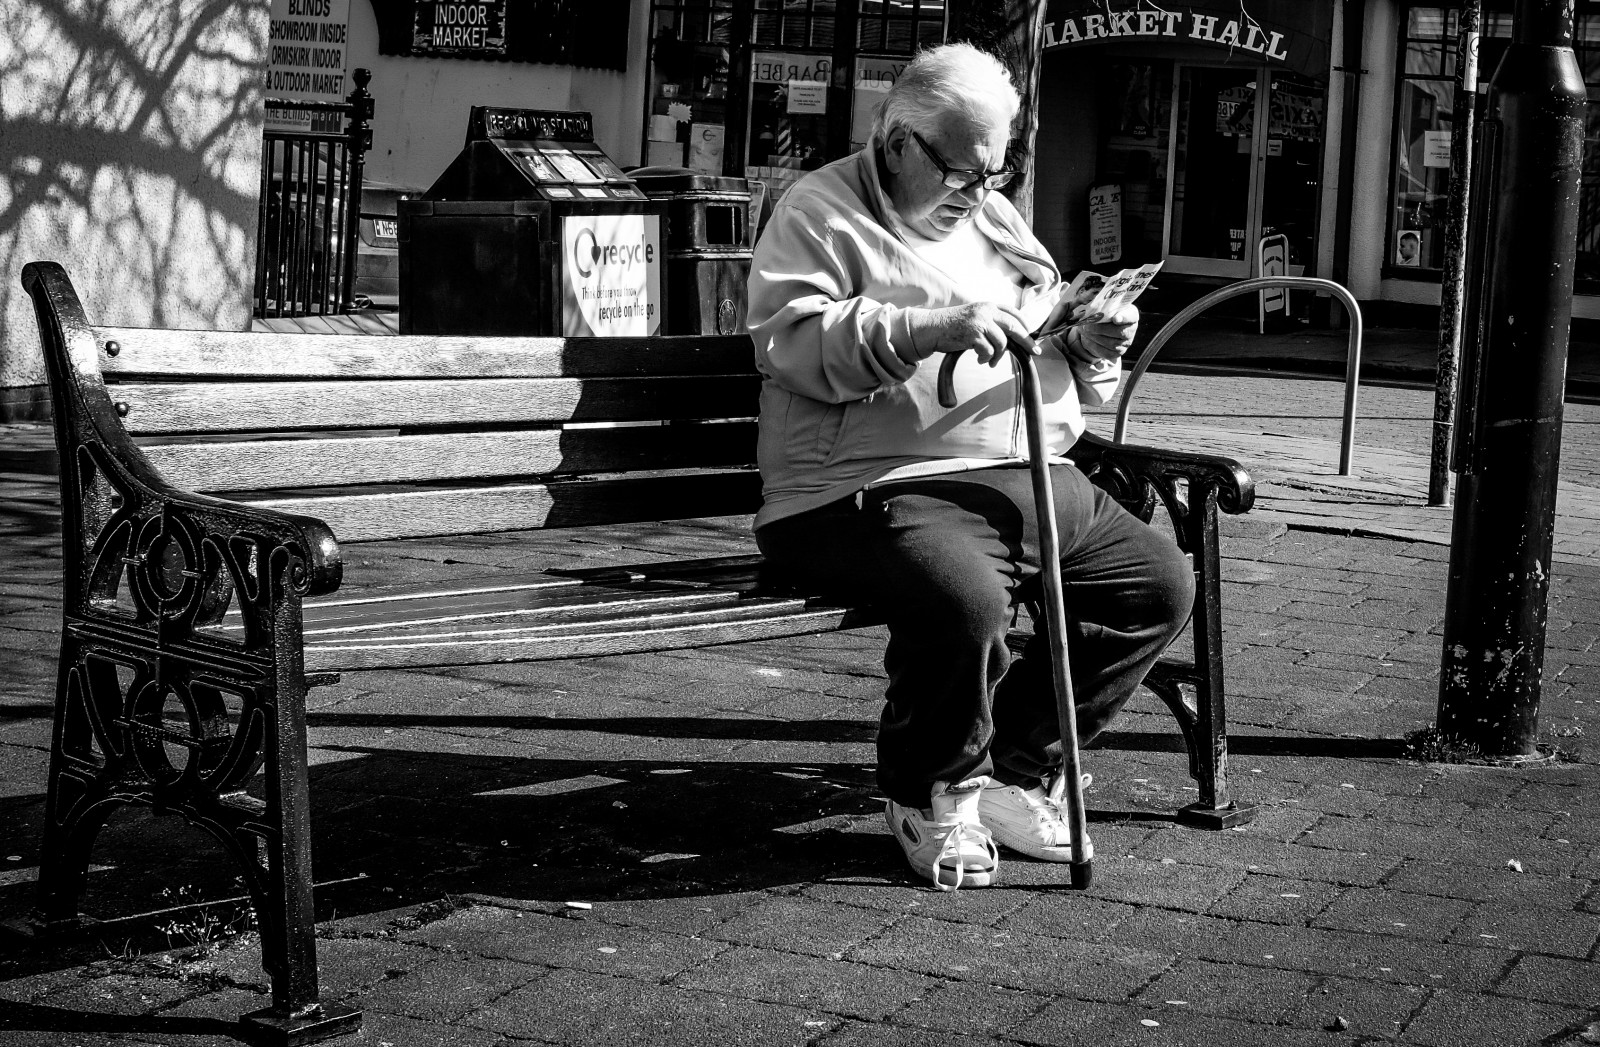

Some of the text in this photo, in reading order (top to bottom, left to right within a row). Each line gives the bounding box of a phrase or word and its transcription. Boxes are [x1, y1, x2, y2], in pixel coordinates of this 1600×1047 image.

[288, 0, 331, 17] BLINDS
[435, 4, 487, 25] INDOOR
[270, 20, 346, 44] SHOWROOM INSIDE
[433, 26, 489, 47] MARKET
[1189, 13, 1288, 61] HALL
[271, 45, 342, 69] ORMSKIRK INDOOR
[266, 70, 344, 95] & OUTDOOR MARKET
[603, 234, 654, 272] recycle
[1093, 236, 1117, 247] INDOOR
[582, 286, 596, 300] Think
[613, 289, 622, 300] you
[599, 298, 655, 324] recycle on the go
